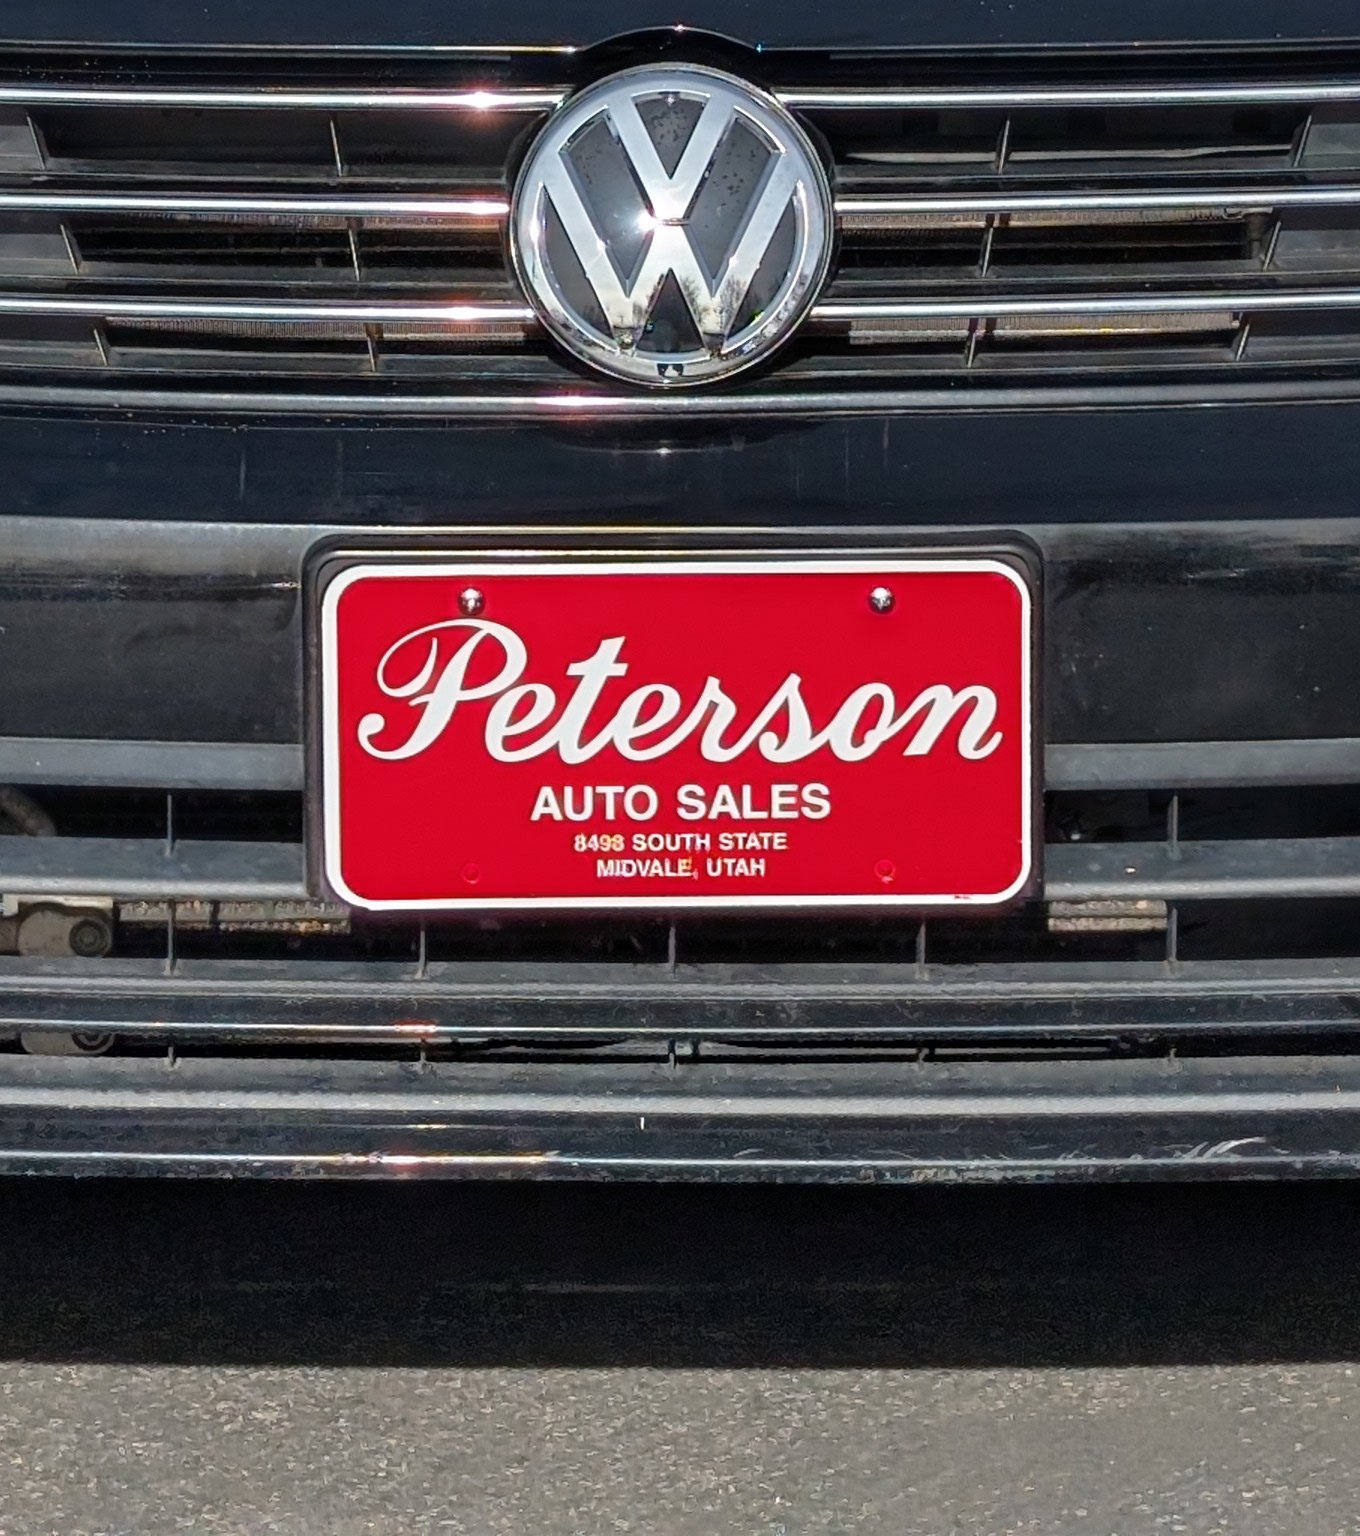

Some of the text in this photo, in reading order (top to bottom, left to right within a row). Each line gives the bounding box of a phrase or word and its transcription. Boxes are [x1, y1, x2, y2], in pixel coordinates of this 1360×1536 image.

[357, 617, 1003, 765] Peterson
[530, 783, 831, 821] AUTO SALES
[574, 832, 789, 853] 8498 SOUTH STATE
[596, 857, 766, 880] MIDVALE, UTAH
